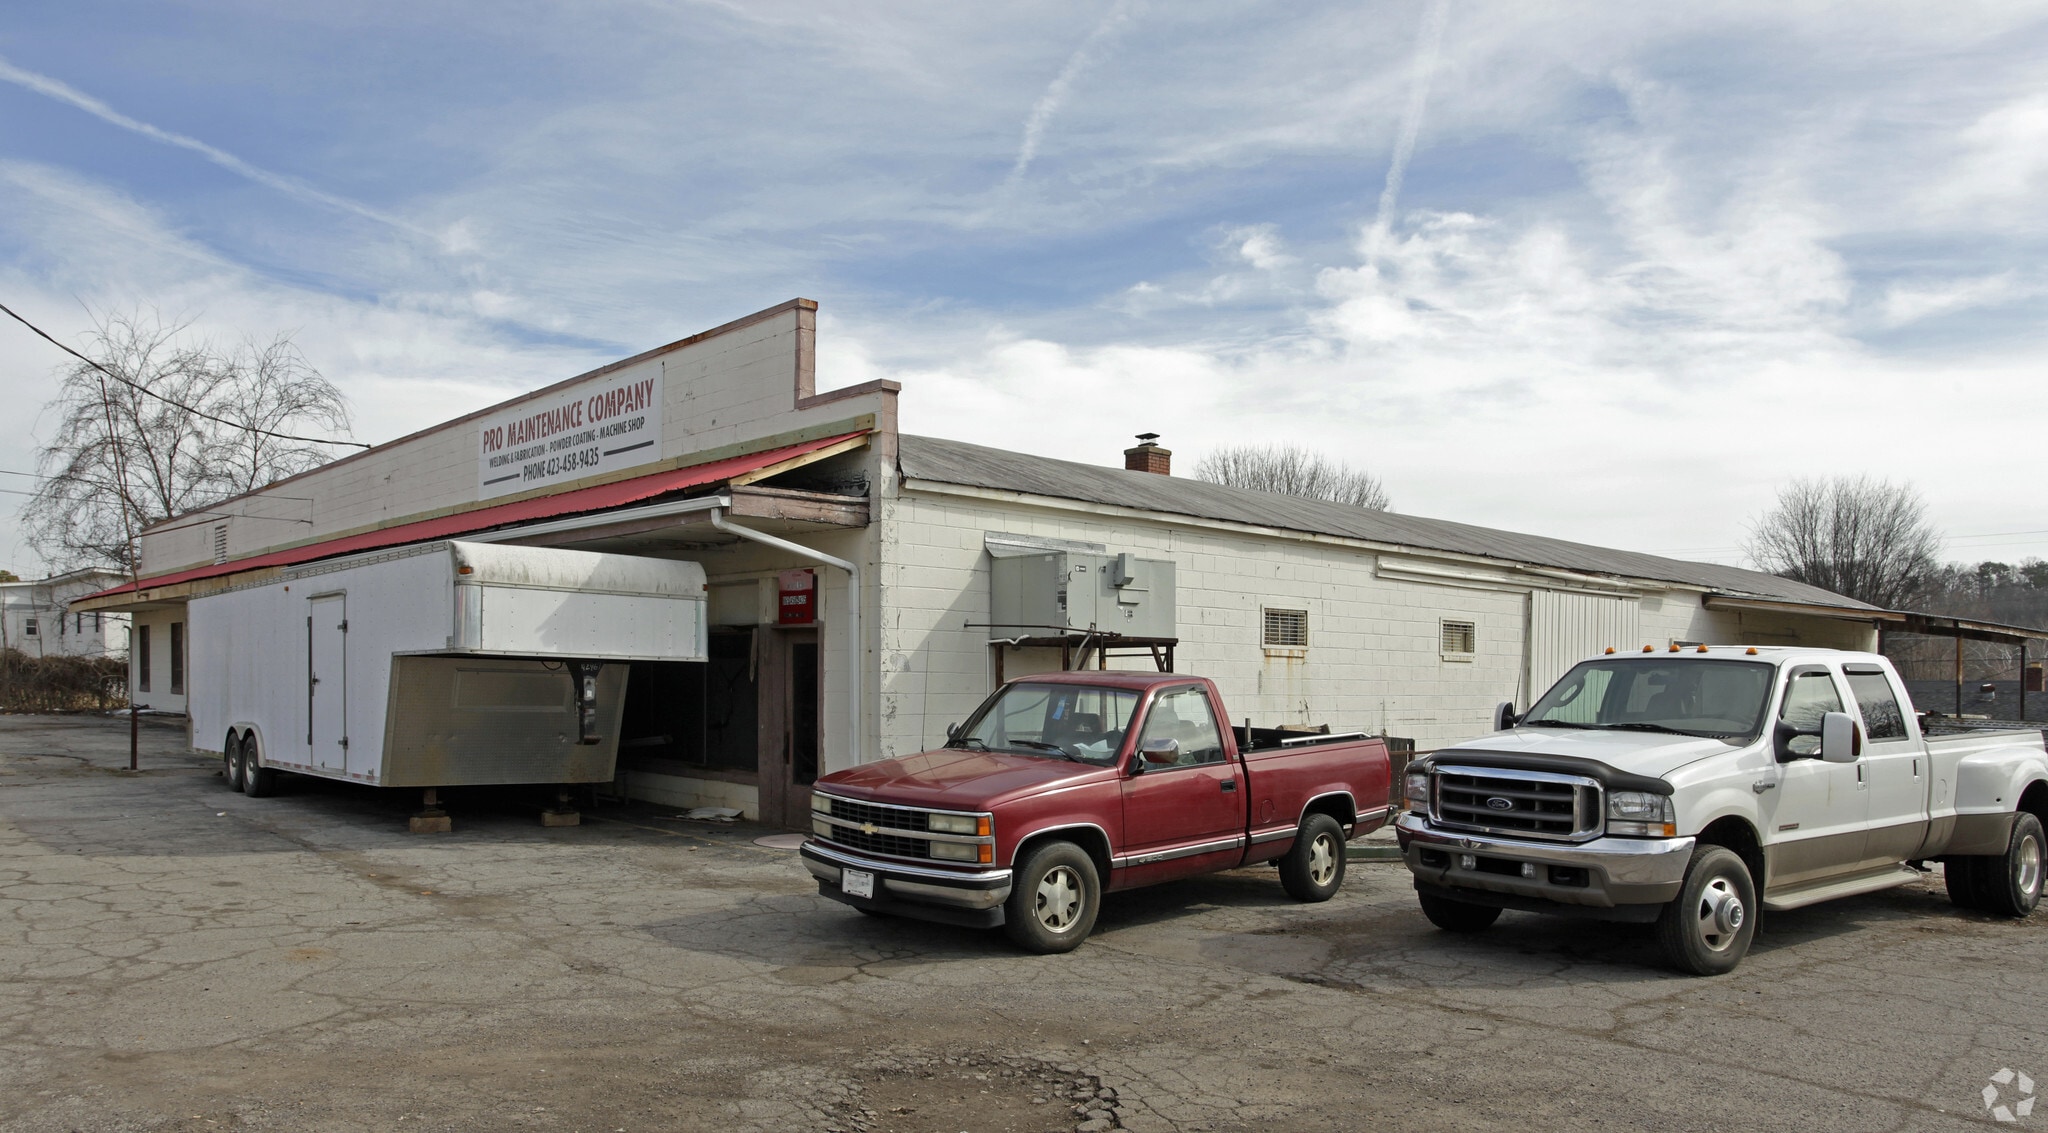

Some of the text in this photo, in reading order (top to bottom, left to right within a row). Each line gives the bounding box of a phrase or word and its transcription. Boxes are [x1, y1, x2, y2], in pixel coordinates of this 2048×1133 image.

[482, 378, 655, 454] PRO MAINTENANCE COMPANY
[489, 453, 510, 469] WELDING
[514, 443, 546, 463] FABRICATION
[549, 435, 571, 454] POWDER
[572, 429, 596, 447] COATING
[600, 420, 627, 440] MACHINE
[628, 416, 645, 432] SHOP
[523, 446, 600, 482] PHONE 423-458-9435
